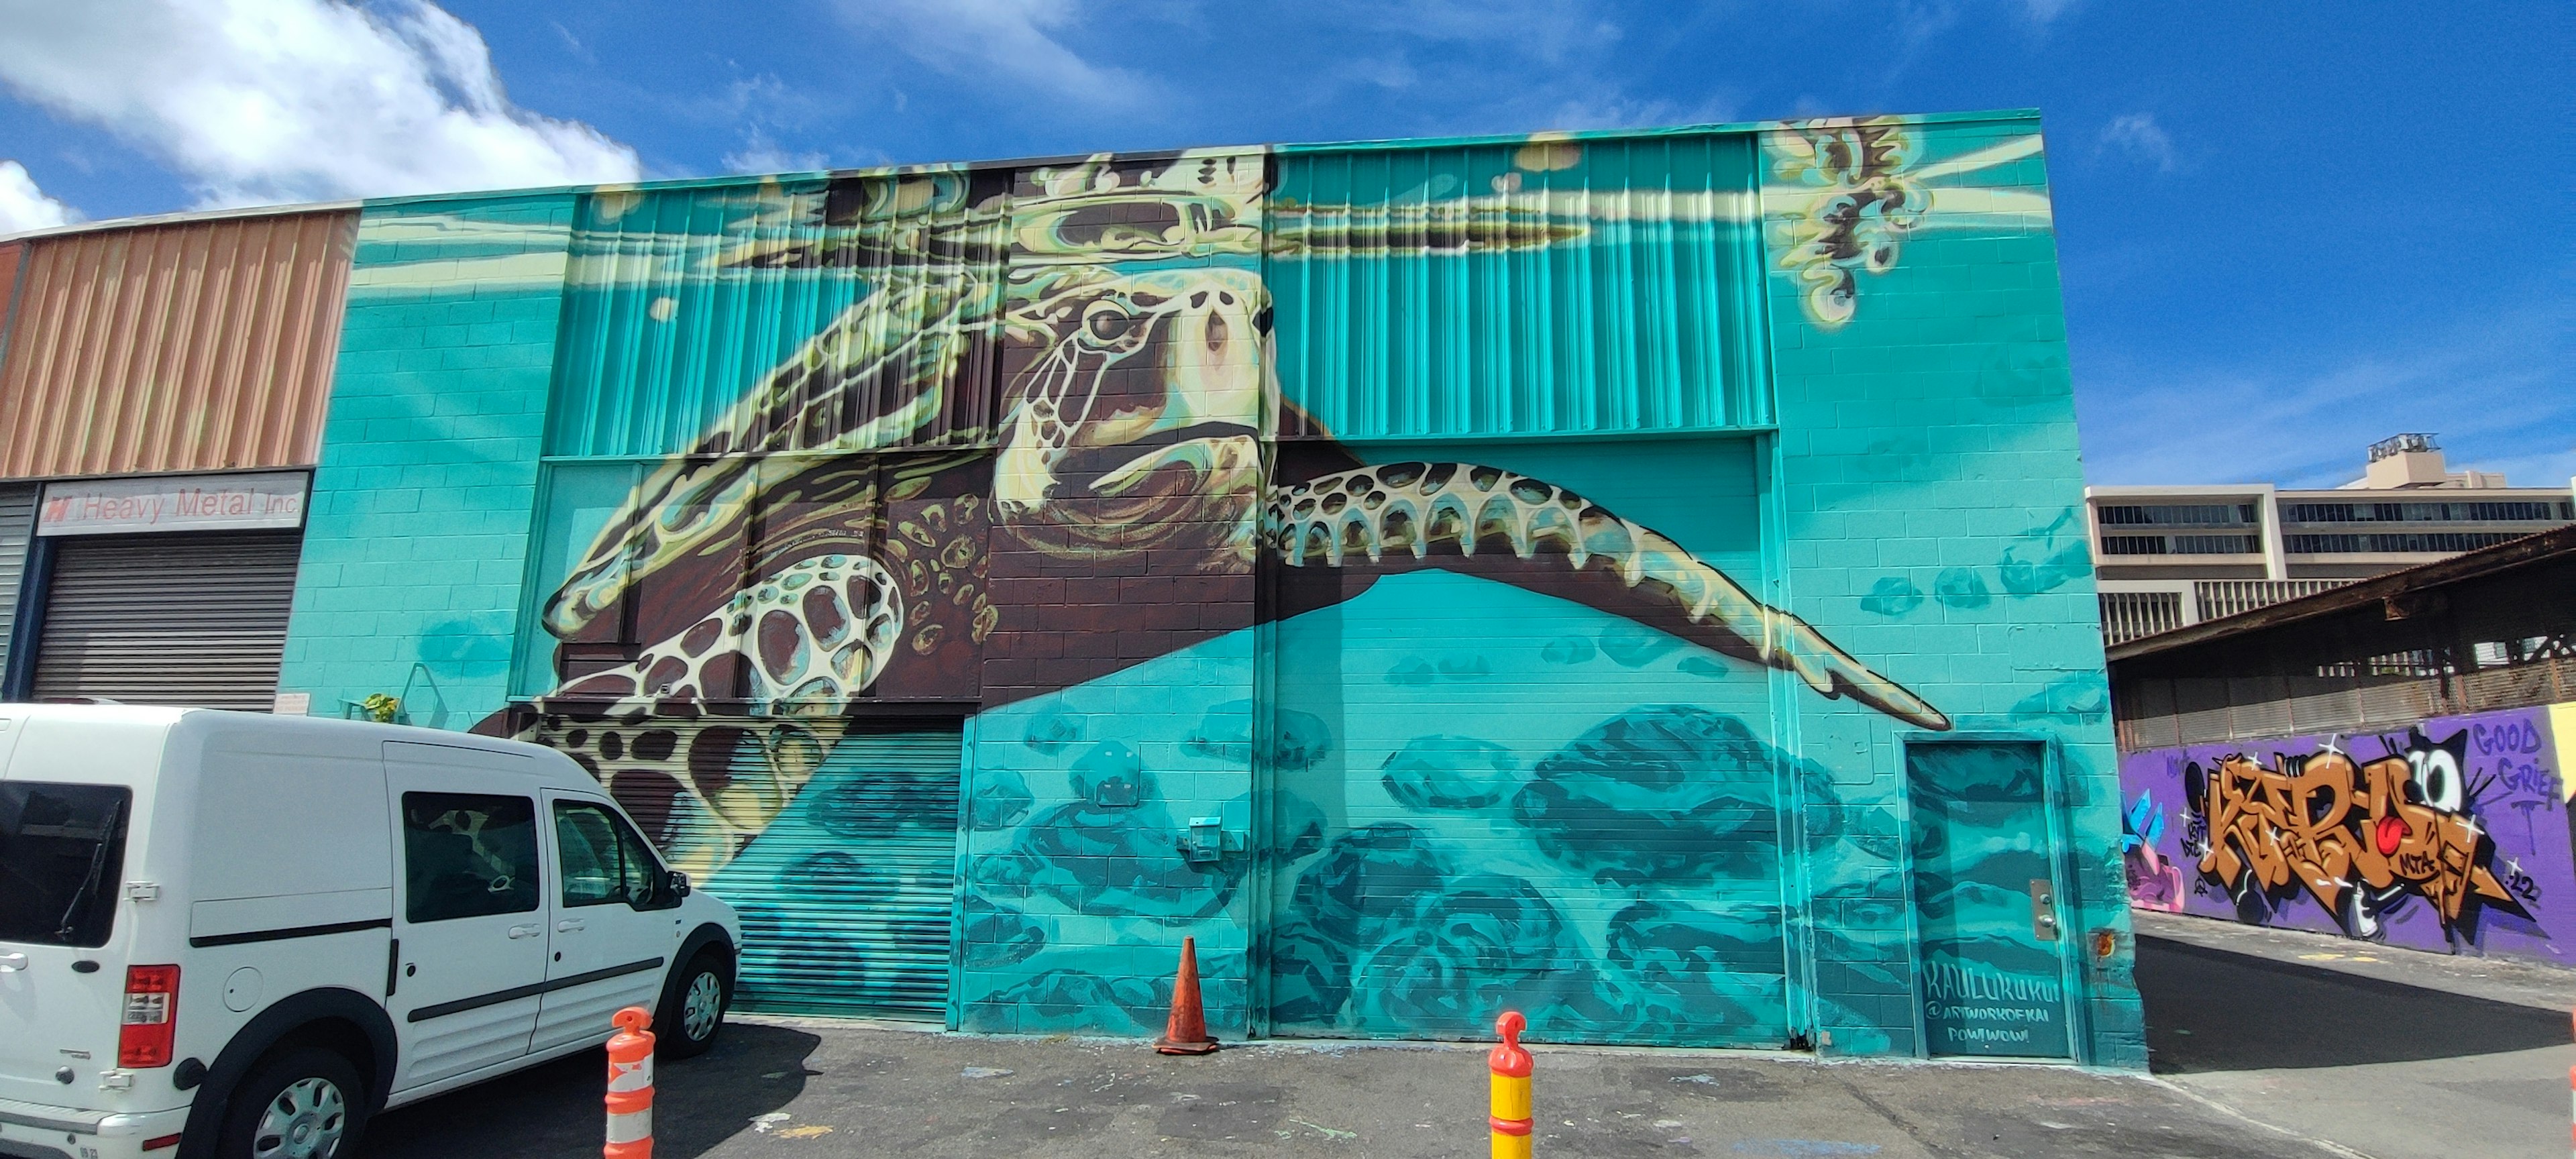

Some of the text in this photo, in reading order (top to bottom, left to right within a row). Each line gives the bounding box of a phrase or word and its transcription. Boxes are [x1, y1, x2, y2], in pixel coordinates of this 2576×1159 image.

[78, 492, 165, 525] Heavy
[176, 488, 254, 516] Metal
[2473, 718, 2542, 755] GOOD
[2400, 850, 2435, 876] MTA
